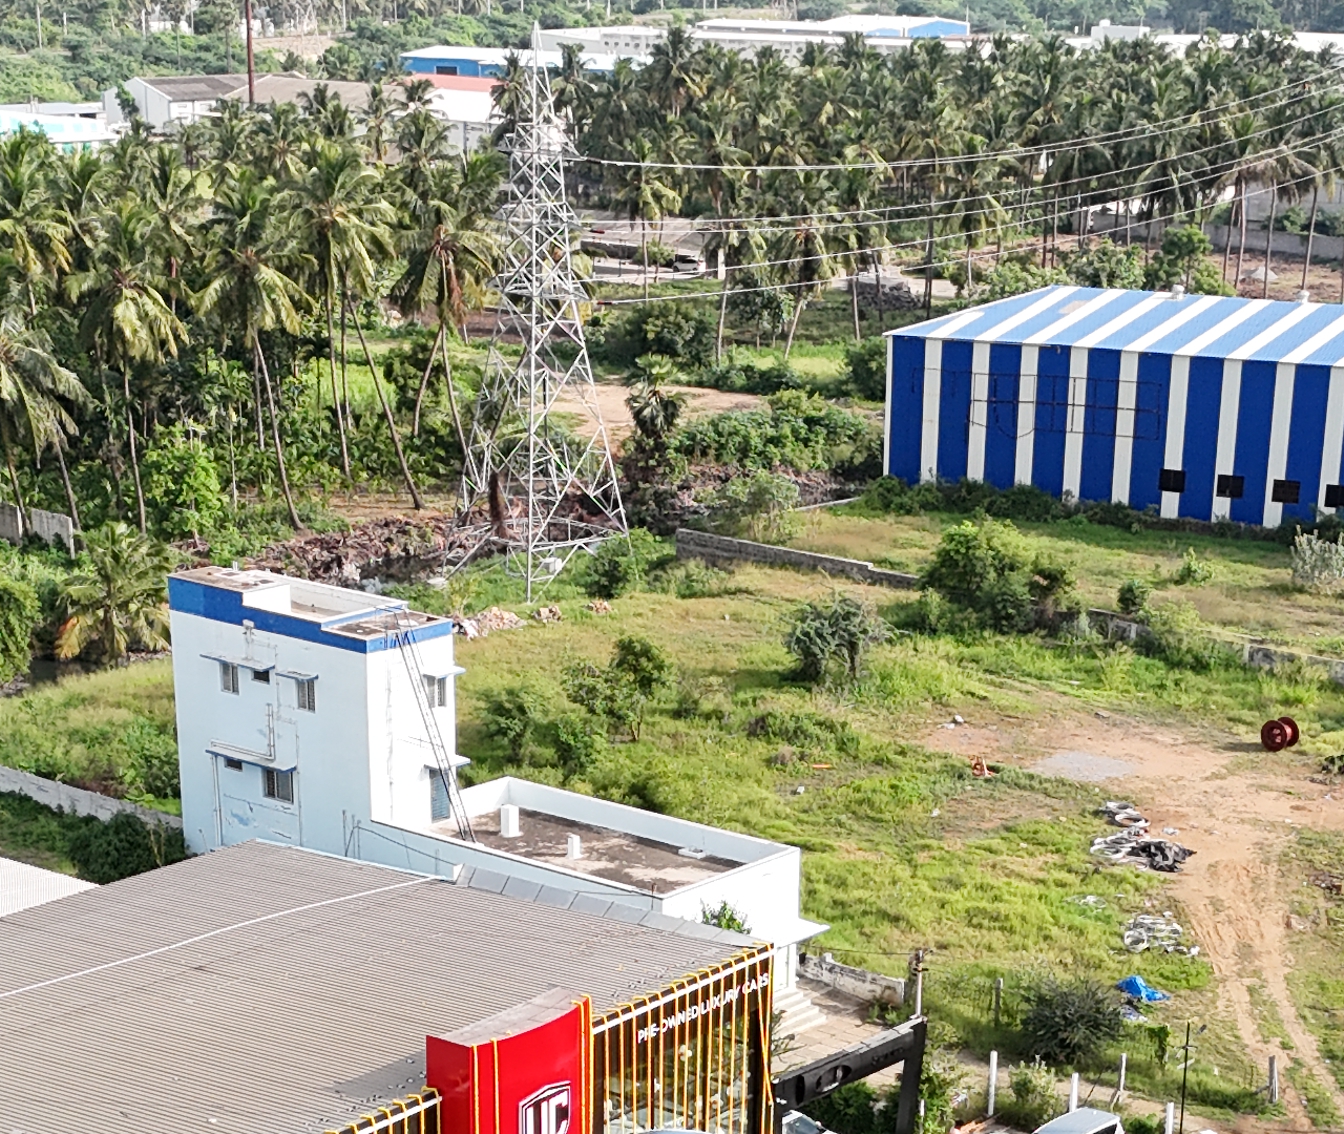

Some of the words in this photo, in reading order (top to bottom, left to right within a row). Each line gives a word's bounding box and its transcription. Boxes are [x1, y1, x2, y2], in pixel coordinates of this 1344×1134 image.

[638, 1007, 699, 1043] PRE-OWNED
[700, 987, 741, 1016] LUXURY
[742, 973, 770, 995] CARS
